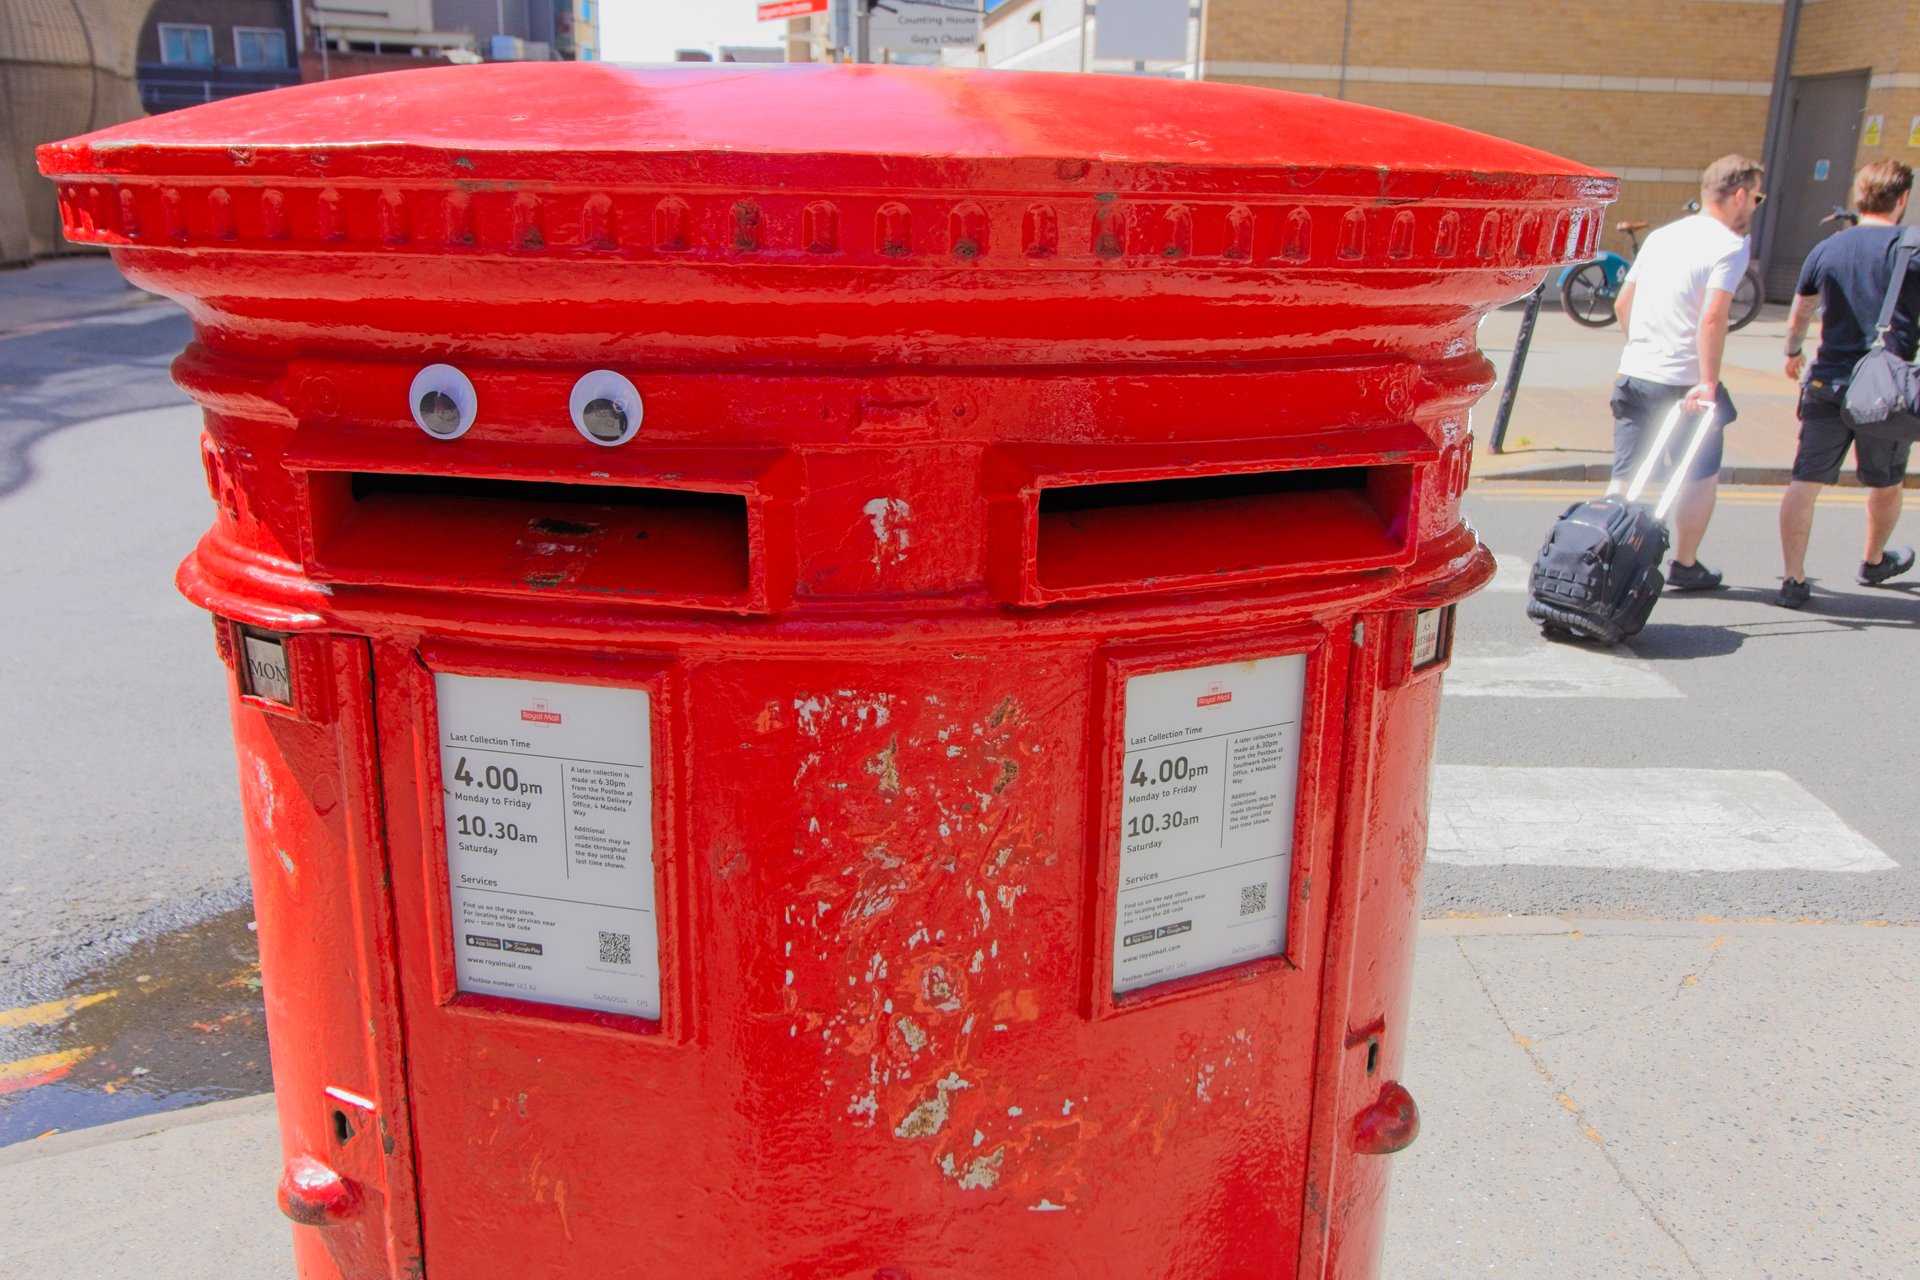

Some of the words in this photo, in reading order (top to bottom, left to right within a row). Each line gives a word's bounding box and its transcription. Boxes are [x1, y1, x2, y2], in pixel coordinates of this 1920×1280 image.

[898, 15, 942, 26] Counting
[945, 16, 976, 24] House
[911, 34, 938, 45] Guy's
[941, 34, 974, 44] Chapel
[249, 659, 287, 683] MON
[1198, 695, 1216, 705] Royal
[1216, 693, 1231, 703] Mail
[522, 711, 543, 721] Royal
[544, 713, 560, 722] Mail
[450, 732, 468, 742] Last
[469, 734, 509, 746] Collection
[510, 738, 531, 748] Time
[1130, 736, 1146, 745] Last
[1148, 730, 1183, 742] Collection
[1184, 726, 1203, 735] Time
[1252, 732, 1277, 741] collection
[1256, 740, 1279, 749] 6.30pm
[1233, 759, 1260, 769] Southwark
[1261, 756, 1281, 764] Delivery
[454, 756, 543, 796] 4.00pm
[593, 769, 622, 777] collection
[1130, 756, 1208, 787] 4.00pm
[598, 778, 626, 788] 6.30pm
[600, 787, 625, 795] Postbox
[1128, 792, 1160, 804] Monday
[1172, 785, 1198, 795] Friday
[455, 791, 489, 806] Monday
[492, 797, 501, 805] to
[504, 797, 531, 810] Friday
[572, 792, 605, 802] Southwark
[606, 796, 632, 805] Delivery
[573, 809, 586, 817] Way
[600, 804, 626, 812] Mandela
[457, 814, 538, 843] 10.30am
[573, 825, 605, 834] Additional
[1127, 811, 1199, 838] 10.30am
[574, 834, 606, 842] collections
[458, 842, 498, 856] Saturday
[593, 844, 628, 853] throughout
[1126, 840, 1163, 854] Saturday
[587, 851, 598, 859] day
[461, 874, 498, 887] Services
[1125, 872, 1159, 885] Services
[1134, 906, 1155, 914] locating
[1172, 897, 1193, 905] services
[474, 910, 498, 919] locating
[517, 917, 541, 925] services
[1122, 944, 1181, 963] www.royalmail.com
[467, 957, 532, 970] www.royalmail.com
[468, 975, 491, 984] Postbox
[1122, 974, 1142, 983] Postbox
[1143, 968, 1164, 977] number
